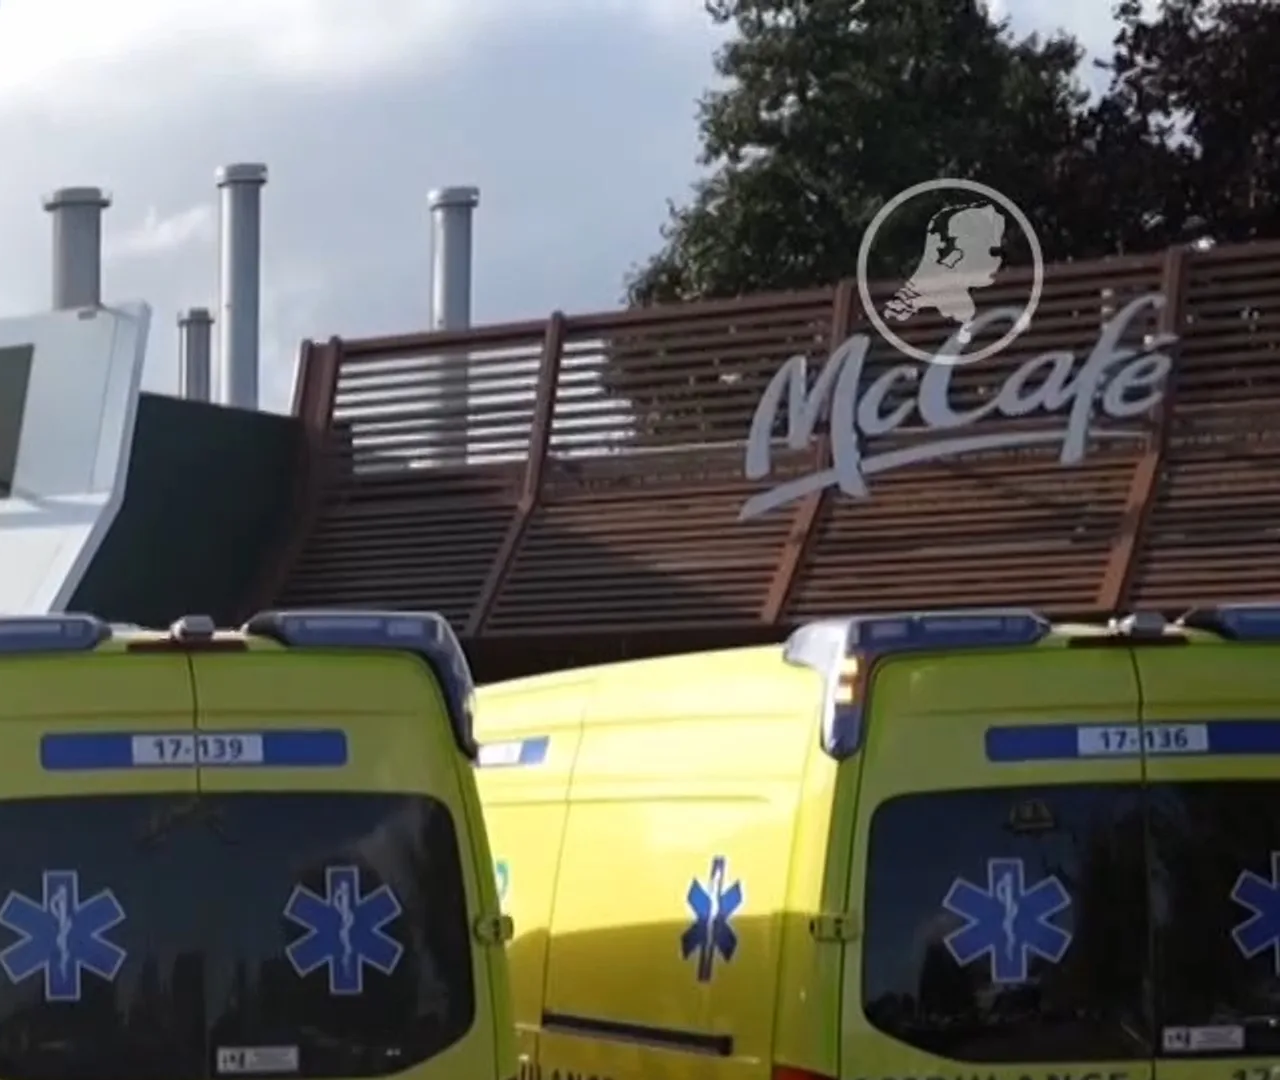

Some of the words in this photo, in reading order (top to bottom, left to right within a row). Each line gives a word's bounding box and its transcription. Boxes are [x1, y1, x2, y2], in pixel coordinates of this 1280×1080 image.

[744, 294, 1178, 498] McCafé
[152, 737, 243, 760] 17-139
[1101, 727, 1188, 750] 17-136
